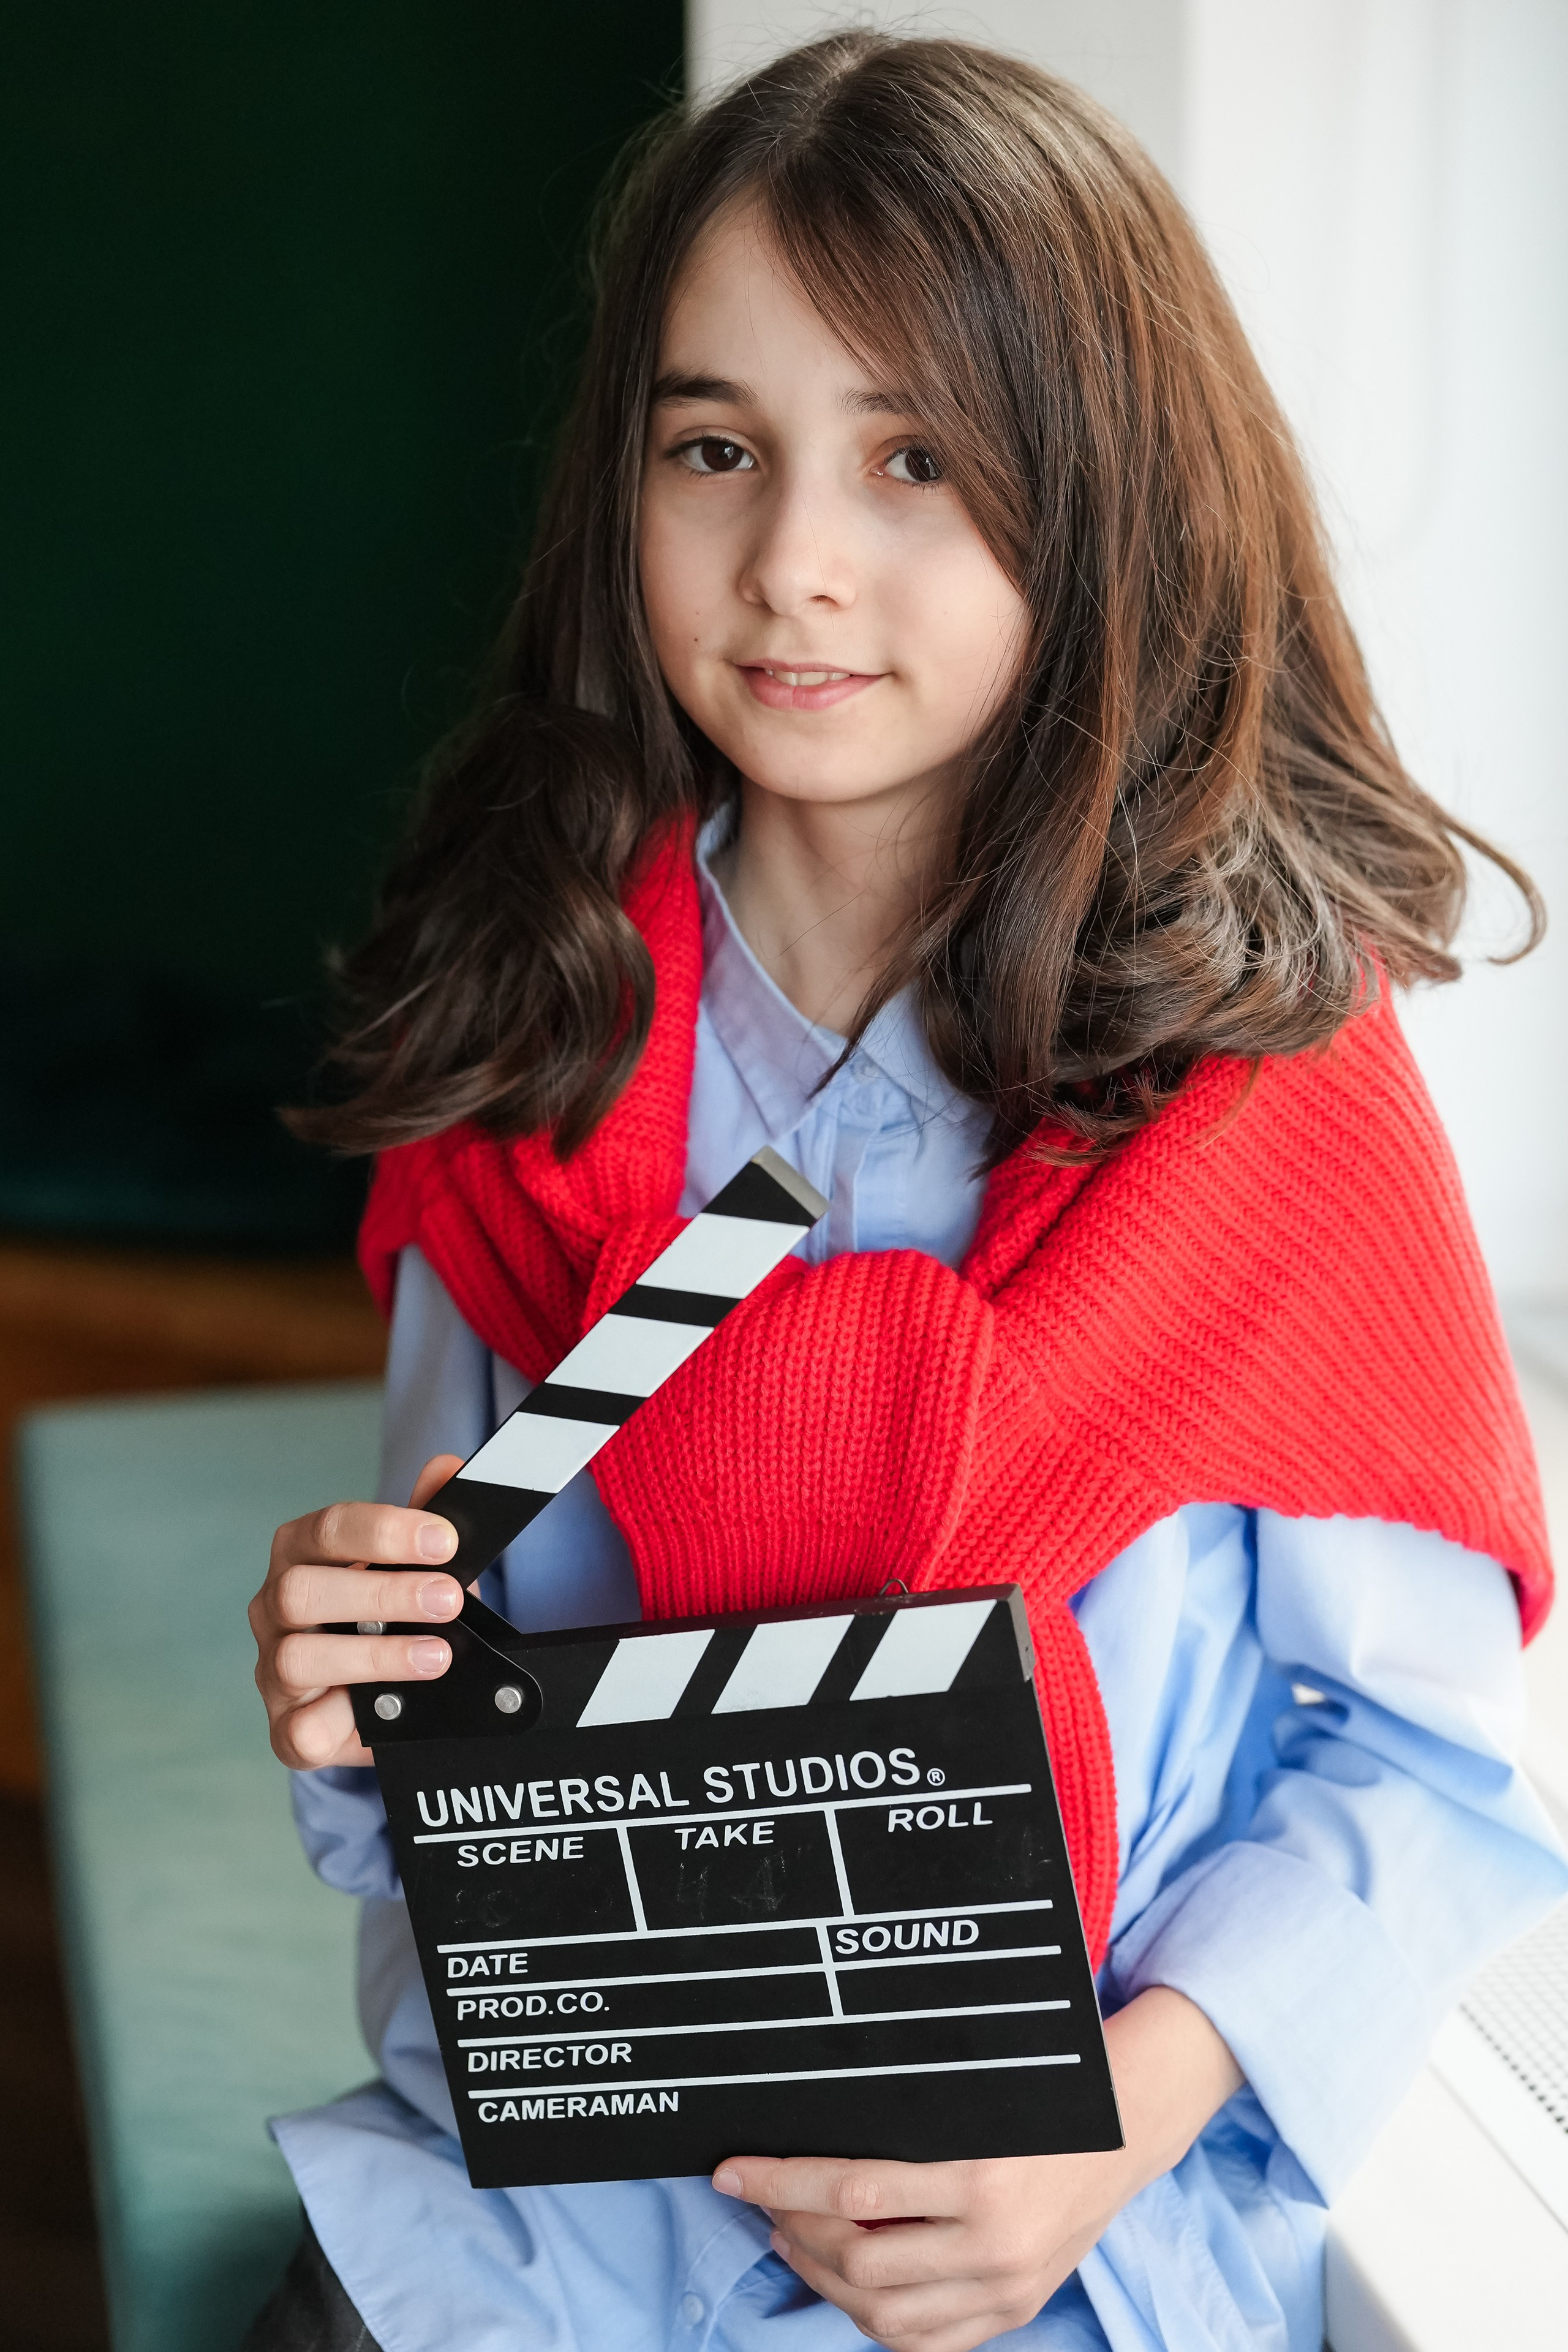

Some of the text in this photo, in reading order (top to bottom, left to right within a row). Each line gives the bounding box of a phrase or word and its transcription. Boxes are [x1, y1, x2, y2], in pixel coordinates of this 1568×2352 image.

[417, 1771, 690, 1827] UNIVERSAL
[888, 1801, 993, 1833] ROLL
[674, 1821, 775, 1850] TAKE
[457, 1836, 584, 1868] SCENE
[835, 1919, 979, 1954] SOUND
[447, 1953, 529, 1978] DATE
[457, 1991, 610, 2021] PROD.CO.
[467, 2043, 632, 2073] DIRECTOR
[478, 2091, 679, 2123] CAMERAMAN
